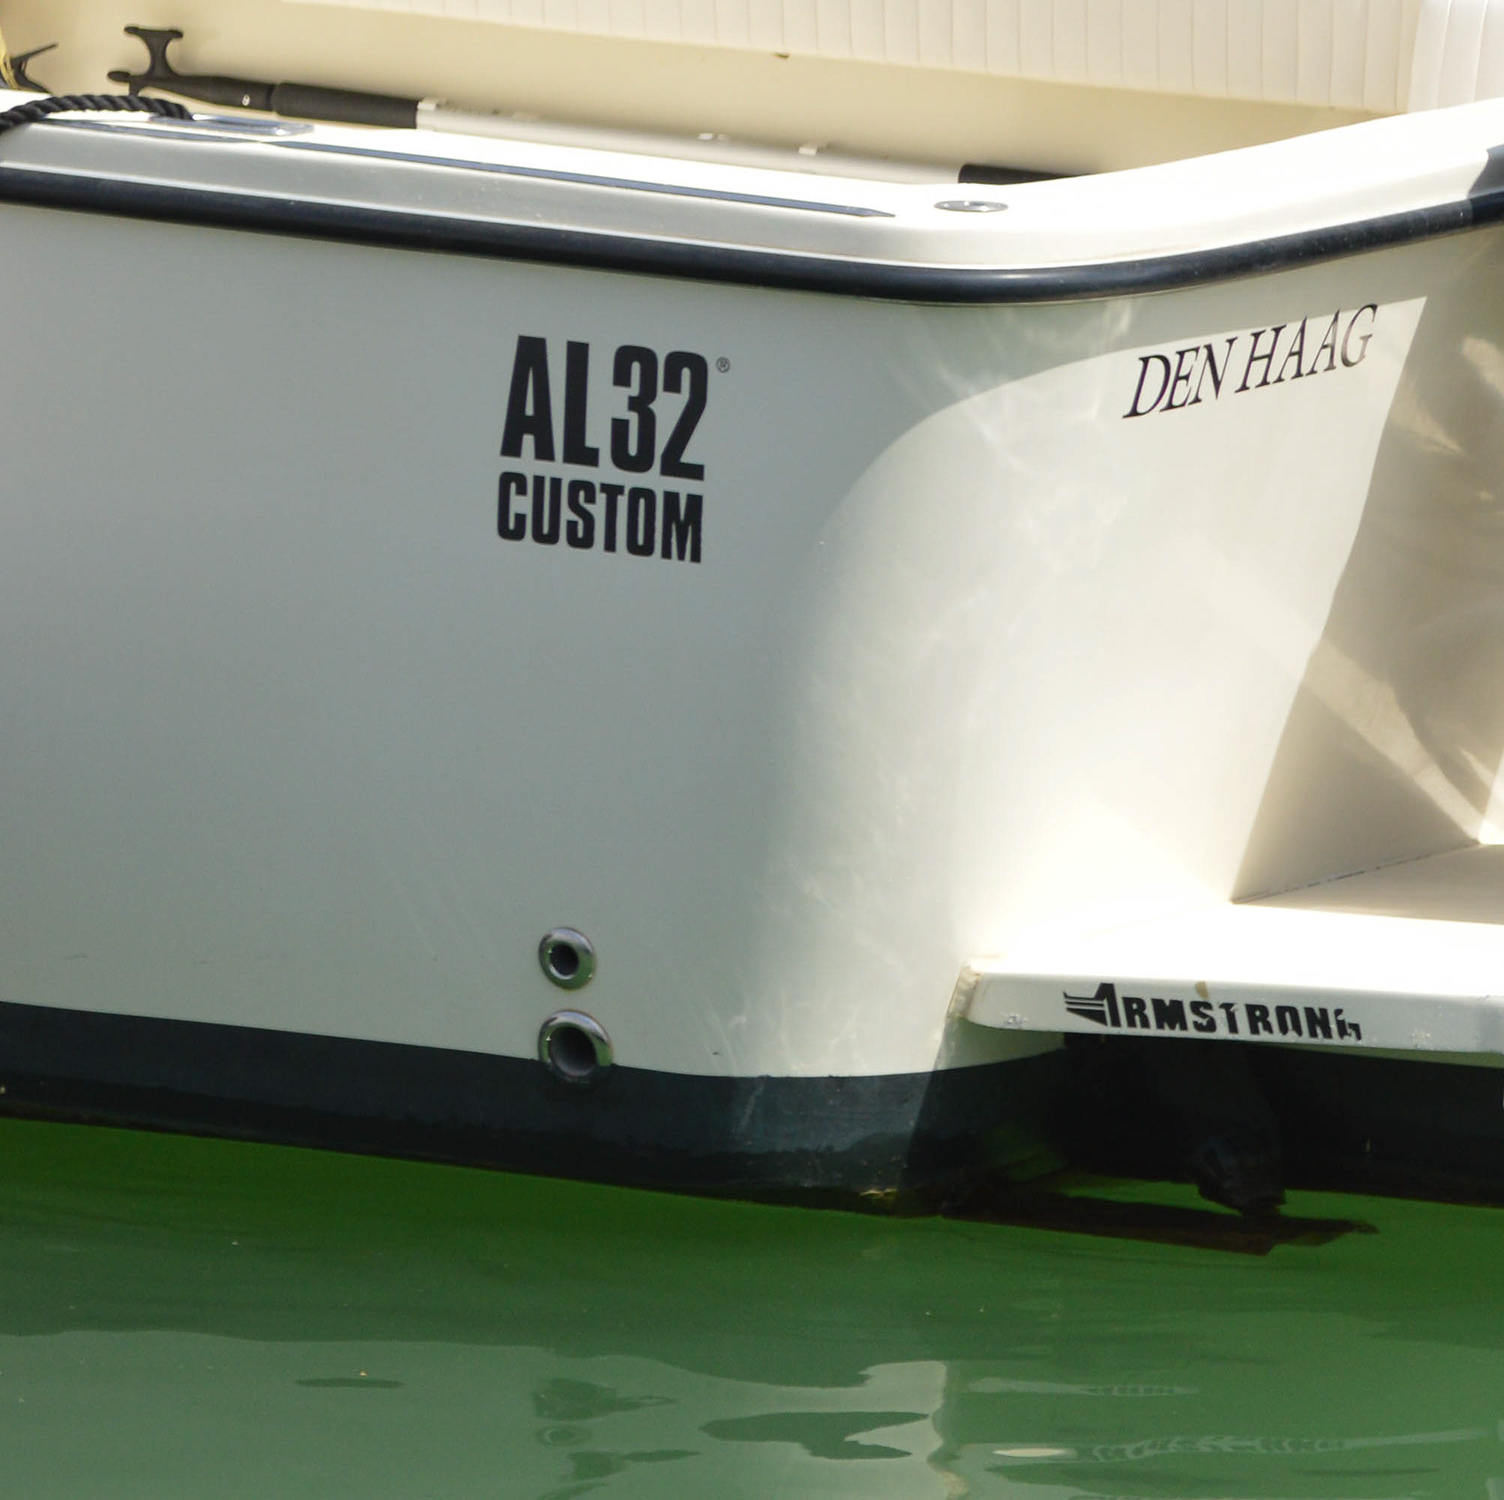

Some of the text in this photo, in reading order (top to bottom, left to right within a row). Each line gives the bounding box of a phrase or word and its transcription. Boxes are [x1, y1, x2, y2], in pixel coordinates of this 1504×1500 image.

[1122, 303, 1379, 419] DEN HAAG
[497, 471, 704, 564] CUSTOM
